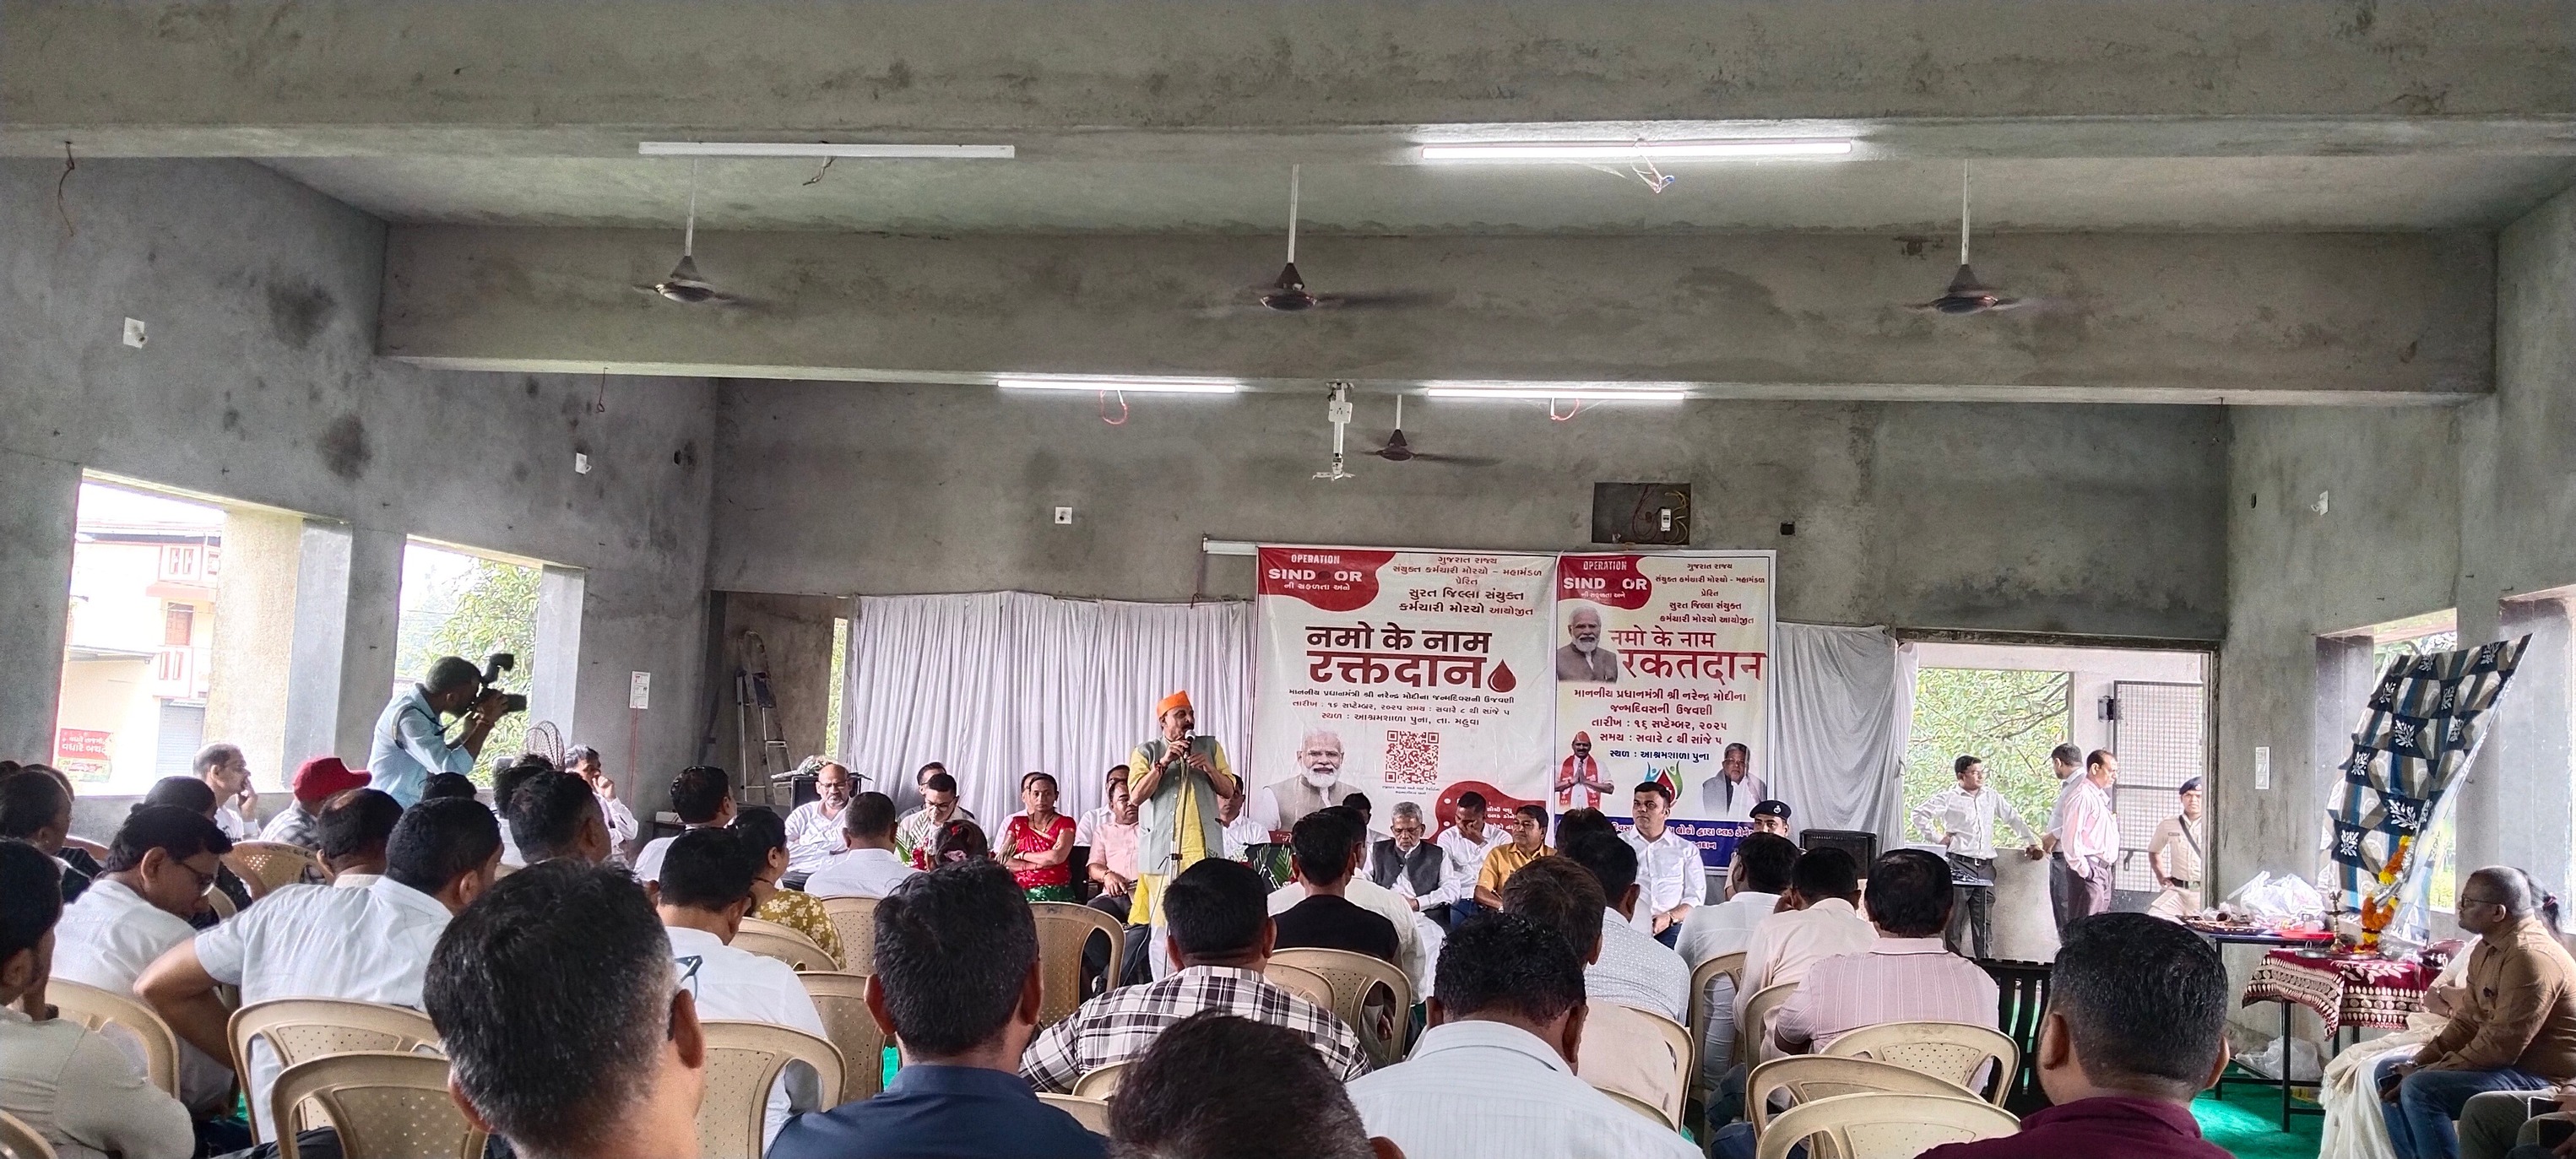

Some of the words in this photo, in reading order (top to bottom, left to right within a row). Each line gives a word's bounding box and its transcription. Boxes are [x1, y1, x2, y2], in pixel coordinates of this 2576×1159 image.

[1291, 554, 1340, 564] OPERATION
[1583, 561, 1627, 571] OPERATION
[1409, 588, 1437, 600] સુરત
[1442, 588, 1479, 599] જિલ્લા
[1398, 601, 1444, 613] કર્મચારી
[1449, 602, 1484, 614] મોરચો
[1669, 602, 1689, 611] સુરત
[1305, 620, 1375, 650] नमो
[1381, 621, 1415, 651] के
[1422, 630, 1493, 653] नाम
[1608, 625, 1647, 647] नमो
[1651, 625, 1673, 648] के
[1677, 631, 1717, 648] नाम
[1307, 650, 1488, 689] रक्तदान
[1574, 686, 1613, 699] માનનીય
[1616, 687, 1663, 700] પ્રધાનમંત્રી
[1667, 689, 1679, 701] શ્રી
[1682, 688, 1710, 701] નરેન્દ્ર
[1713, 689, 1746, 702] મોદીના
[1609, 702, 1669, 714] જન્મદિવસની
[1676, 704, 1712, 716] ઉજવણી
[1592, 716, 1622, 728] તારીખ
[1635, 719, 1647, 729] ૧૬
[1699, 722, 1727, 731] ૨૦૨૫
[1599, 733, 1624, 742] સમય
[1636, 731, 1662, 743] સવારે
[1677, 733, 1688, 744] થી
[1690, 733, 1712, 745] સાંજે
[1609, 750, 1630, 758] સ્થળ
[1640, 750, 1689, 760] આશ્રમશાળા
[1692, 752, 1710, 762] પુના
